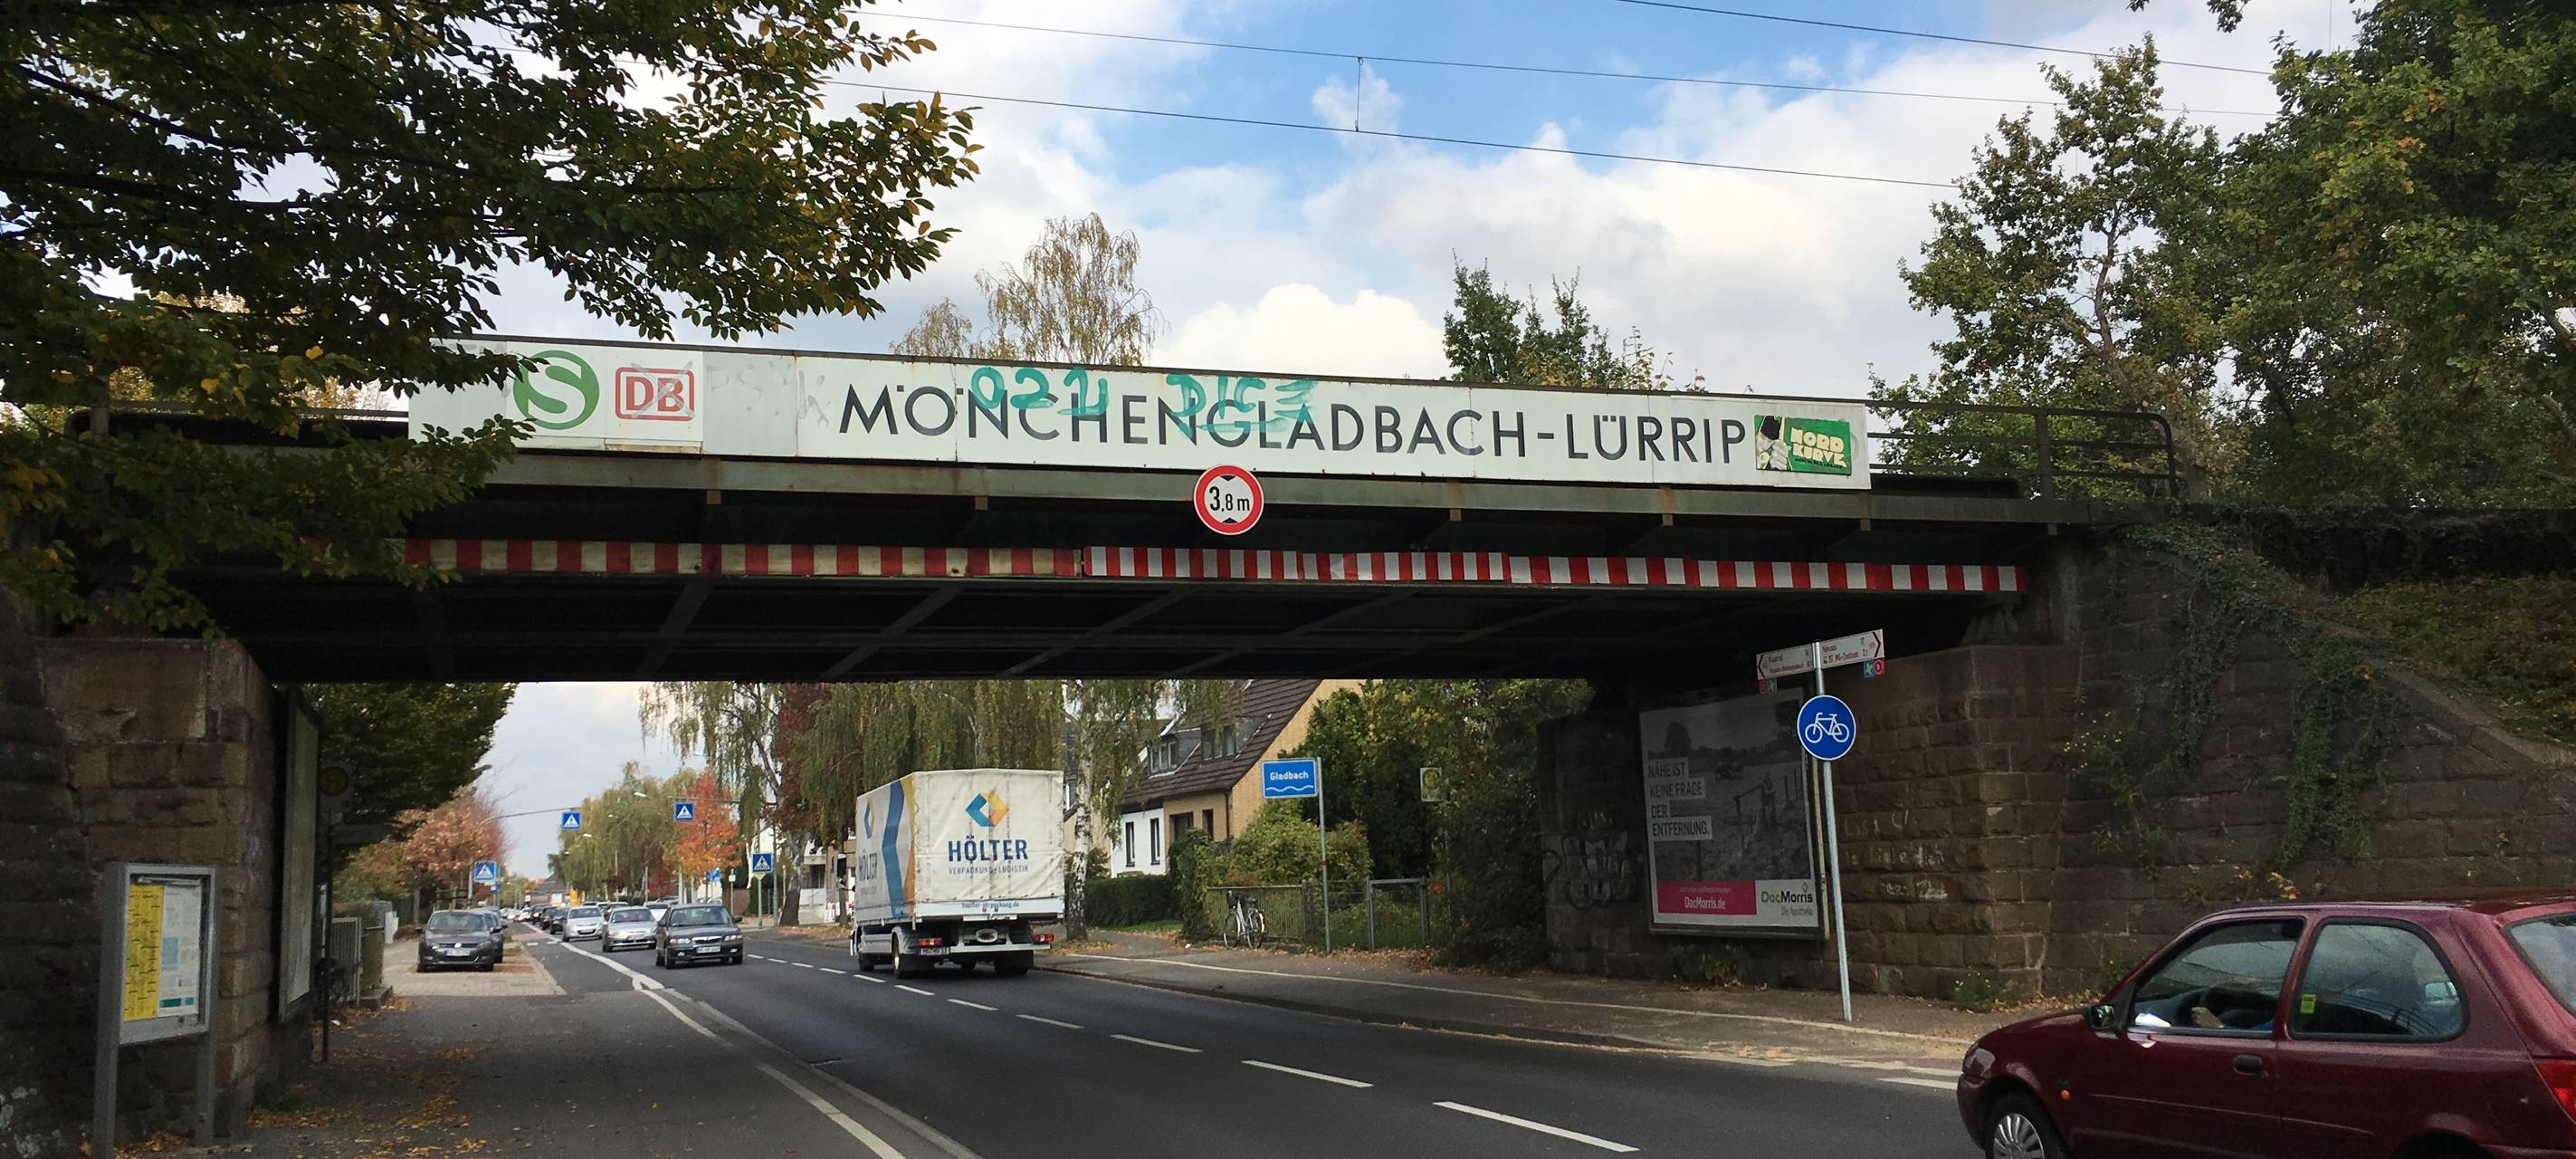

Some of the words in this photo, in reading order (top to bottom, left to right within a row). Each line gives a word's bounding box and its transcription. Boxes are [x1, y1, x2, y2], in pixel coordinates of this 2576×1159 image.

[625, 377, 685, 412] DB
[1790, 427, 1844, 453] NORD
[1792, 444, 1846, 467] KURVE
[1208, 485, 1235, 513] 3,8
[1236, 497, 1251, 512] m
[1269, 771, 1309, 781] Gladbach
[1648, 761, 1671, 778] NÄHE
[1672, 761, 1685, 776] IST
[1650, 782, 1674, 798] KEINE
[1674, 781, 1703, 796] FRAGE
[1651, 804, 1667, 819] DER
[949, 834, 1028, 861] HÖLTER
[1684, 896, 1726, 910] DocMorris.de
[1760, 890, 1813, 903] DocMorris
